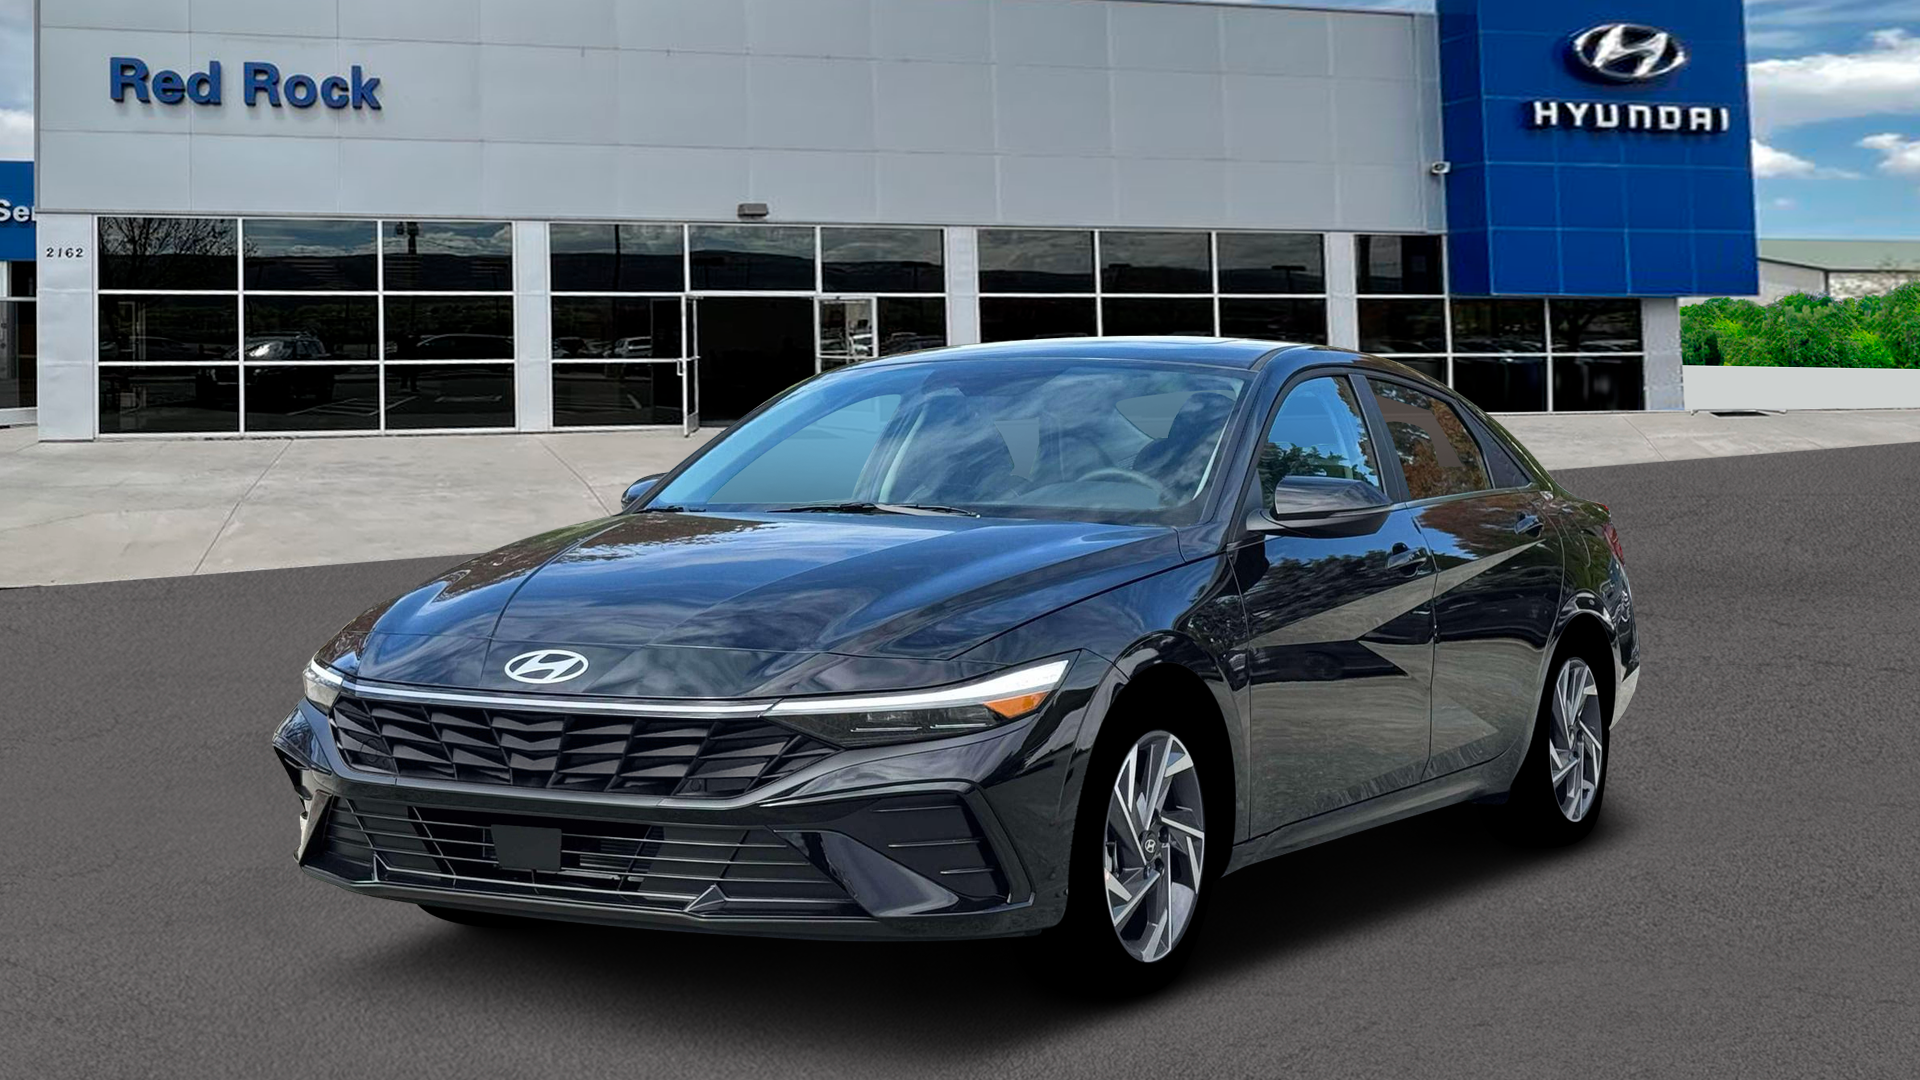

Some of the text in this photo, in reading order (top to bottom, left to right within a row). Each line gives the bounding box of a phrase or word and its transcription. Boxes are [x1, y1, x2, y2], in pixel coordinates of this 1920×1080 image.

[109, 56, 382, 110] Red Rock
[1533, 101, 1729, 132] HYUNDAI
[46, 247, 83, 258] 2162
